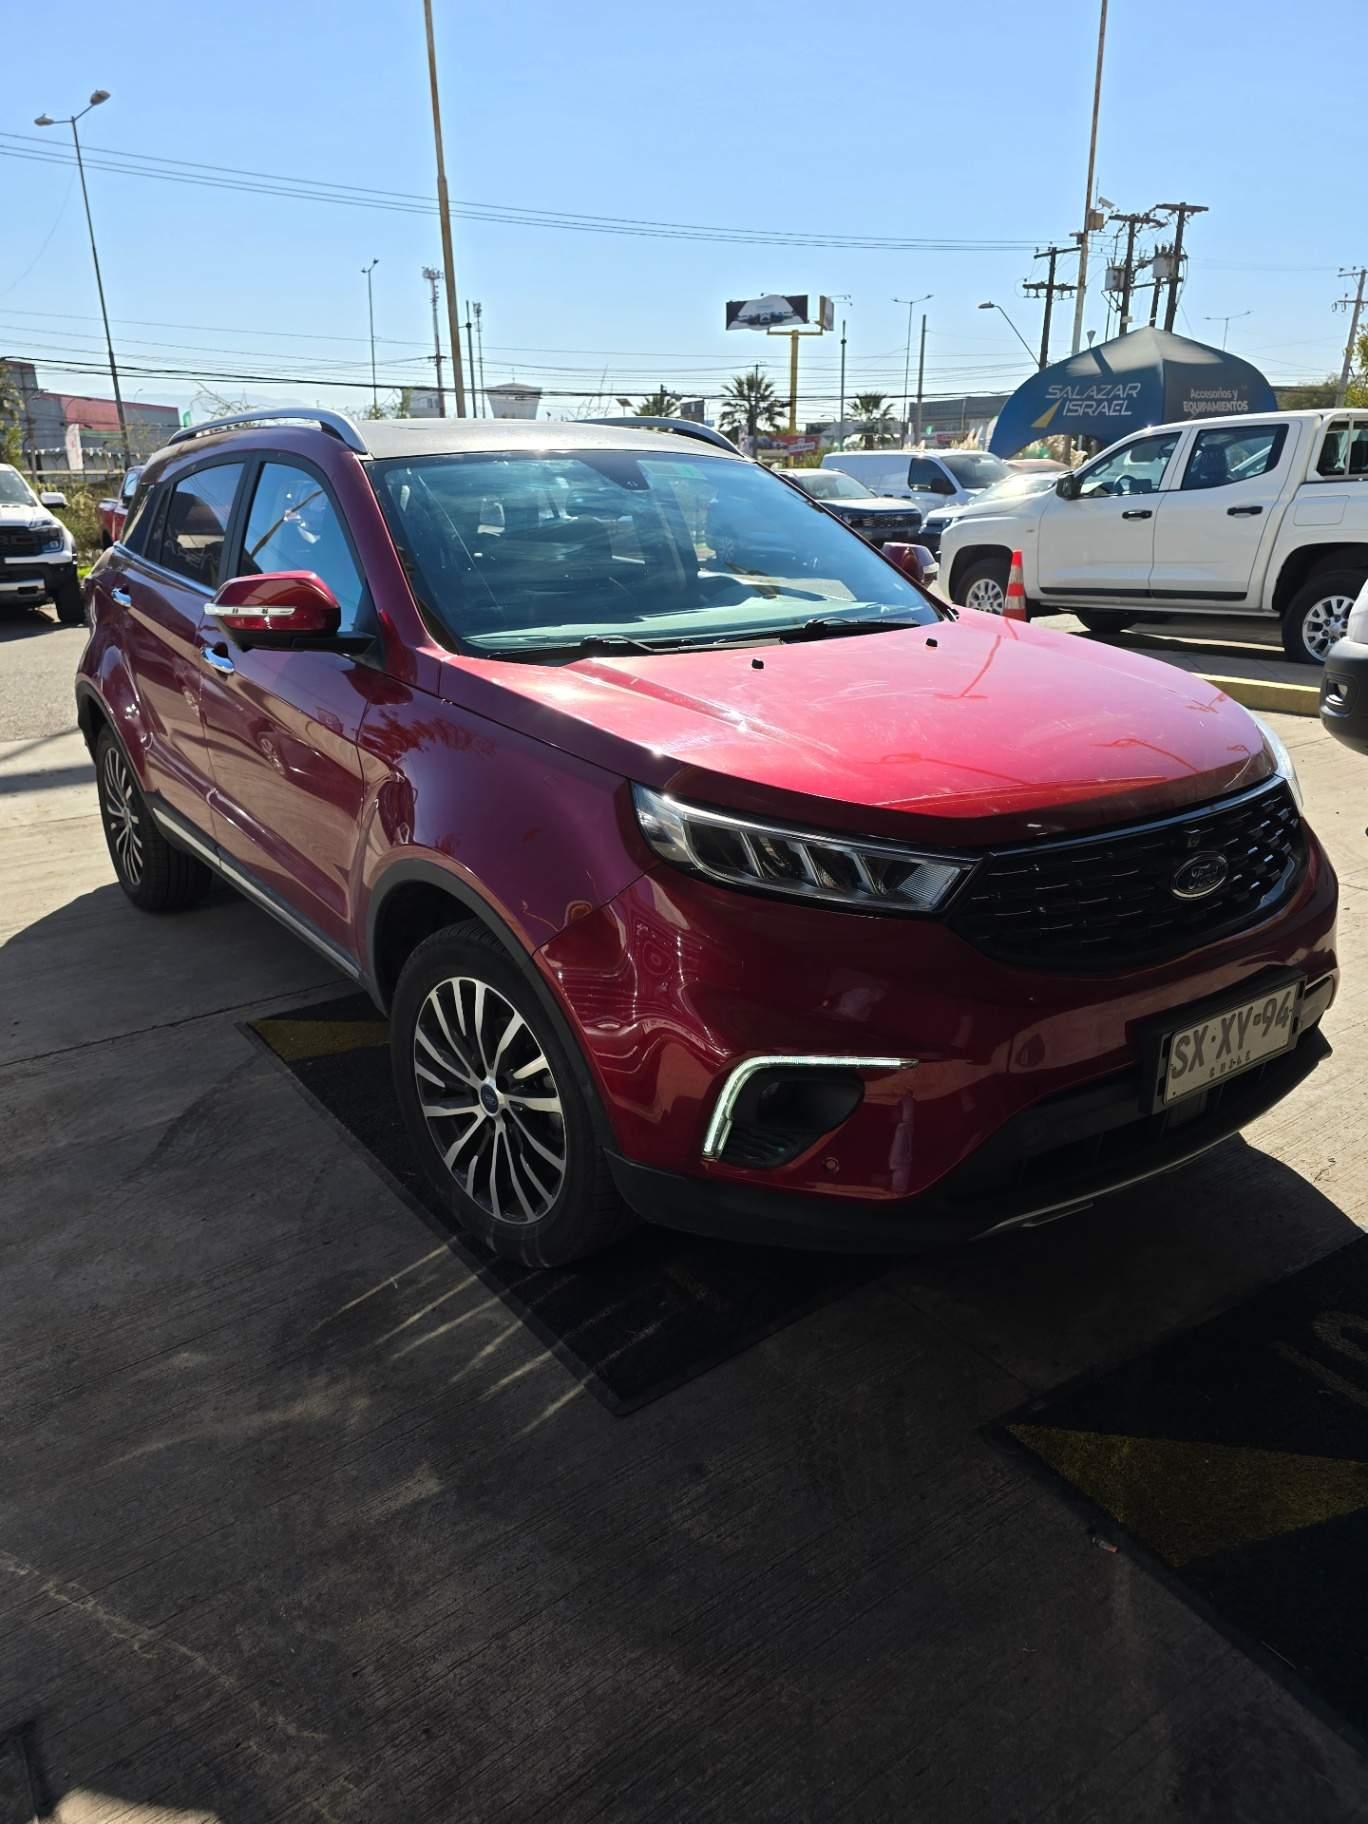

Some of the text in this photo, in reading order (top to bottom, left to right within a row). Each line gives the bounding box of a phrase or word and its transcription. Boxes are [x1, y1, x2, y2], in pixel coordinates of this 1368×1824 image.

[1045, 382, 1141, 399] SALAZAR
[1062, 400, 1133, 416] ISRAEL
[1183, 400, 1249, 414] EQUIPAMIENTOS
